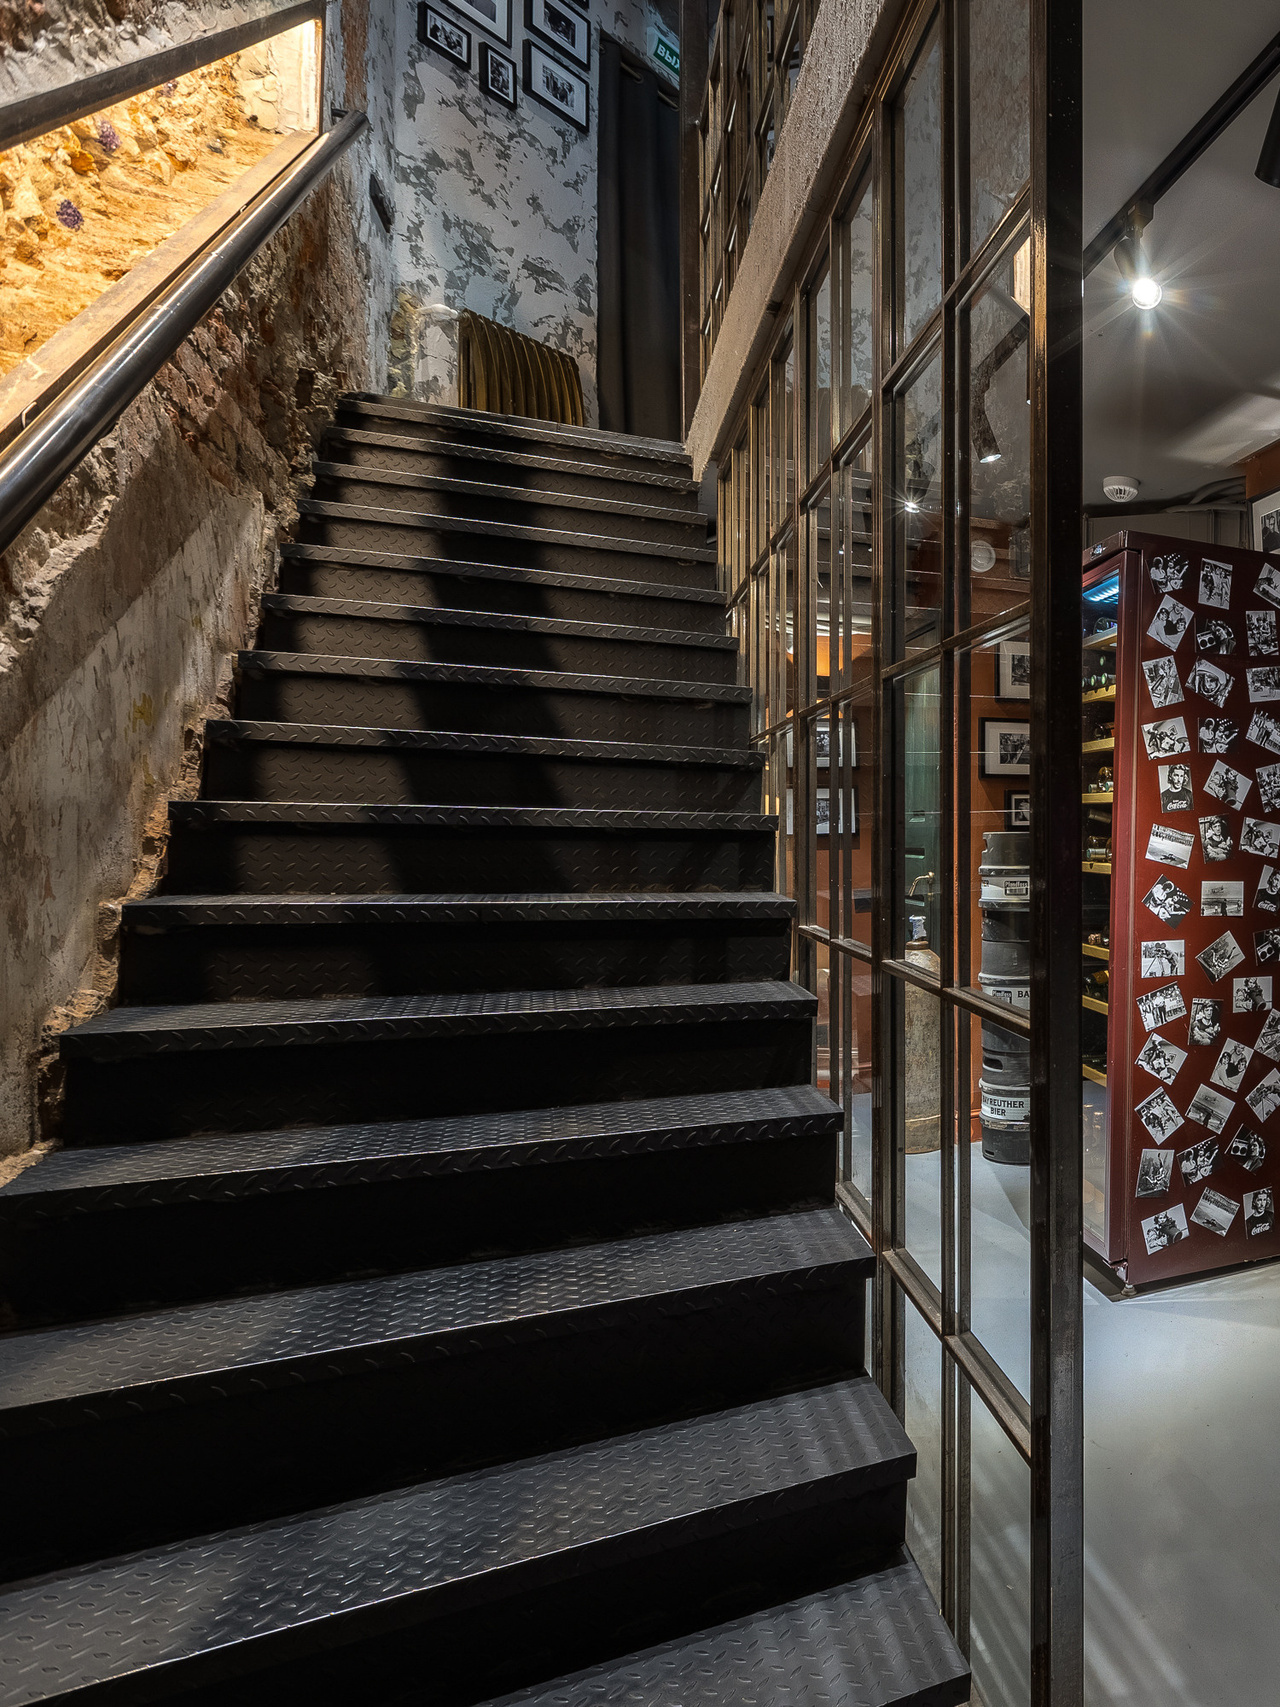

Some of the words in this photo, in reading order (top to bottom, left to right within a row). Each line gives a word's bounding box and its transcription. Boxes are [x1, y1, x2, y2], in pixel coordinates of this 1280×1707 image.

[1018, 990, 1030, 998] BA
[982, 1095, 1024, 1108] BAYREUTHER
[990, 1107, 1006, 1116] BIER
